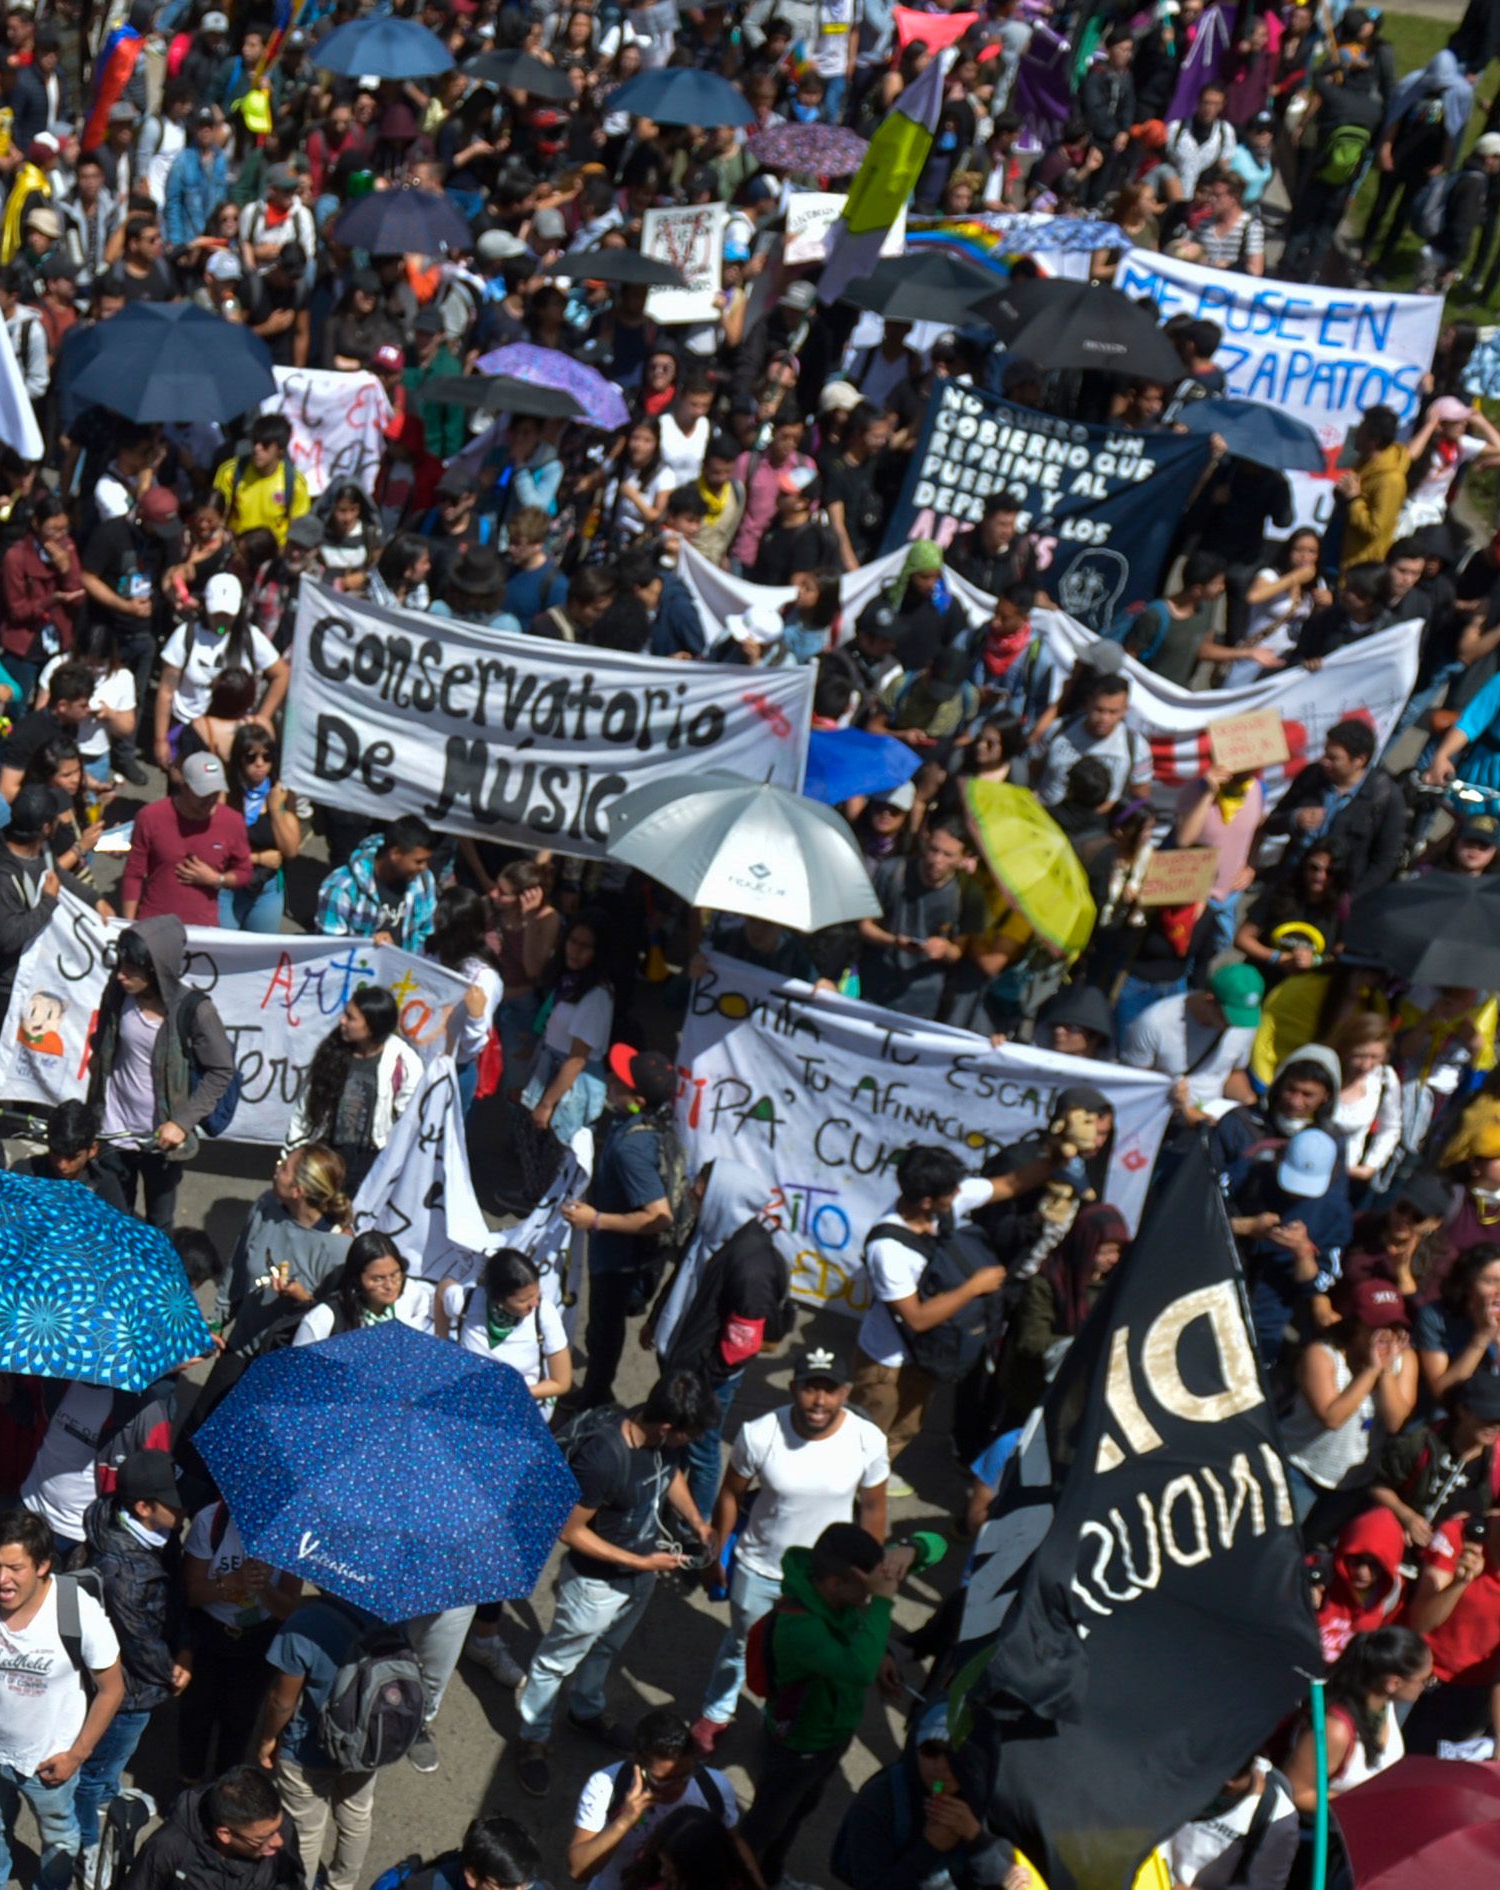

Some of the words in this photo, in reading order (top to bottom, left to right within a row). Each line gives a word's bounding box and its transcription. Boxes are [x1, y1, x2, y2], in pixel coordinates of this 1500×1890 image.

[1197, 283, 1312, 342] PUSE
[1318, 300, 1396, 352] EN
[1217, 341, 1421, 419] ZAPATOS
[934, 409, 1091, 470] GOBIERNO
[1093, 450, 1157, 482] QUE
[940, 385, 985, 416] NO
[994, 405, 1090, 443] QUIERO
[1104, 431, 1146, 456] UN
[928, 430, 1065, 490] REPRIME
[1069, 470, 1109, 500] AL
[1040, 488, 1065, 514] Y
[1059, 516, 1112, 545] LOS
[314, 713, 397, 795] De
[422, 735, 629, 844] MÚSIC
